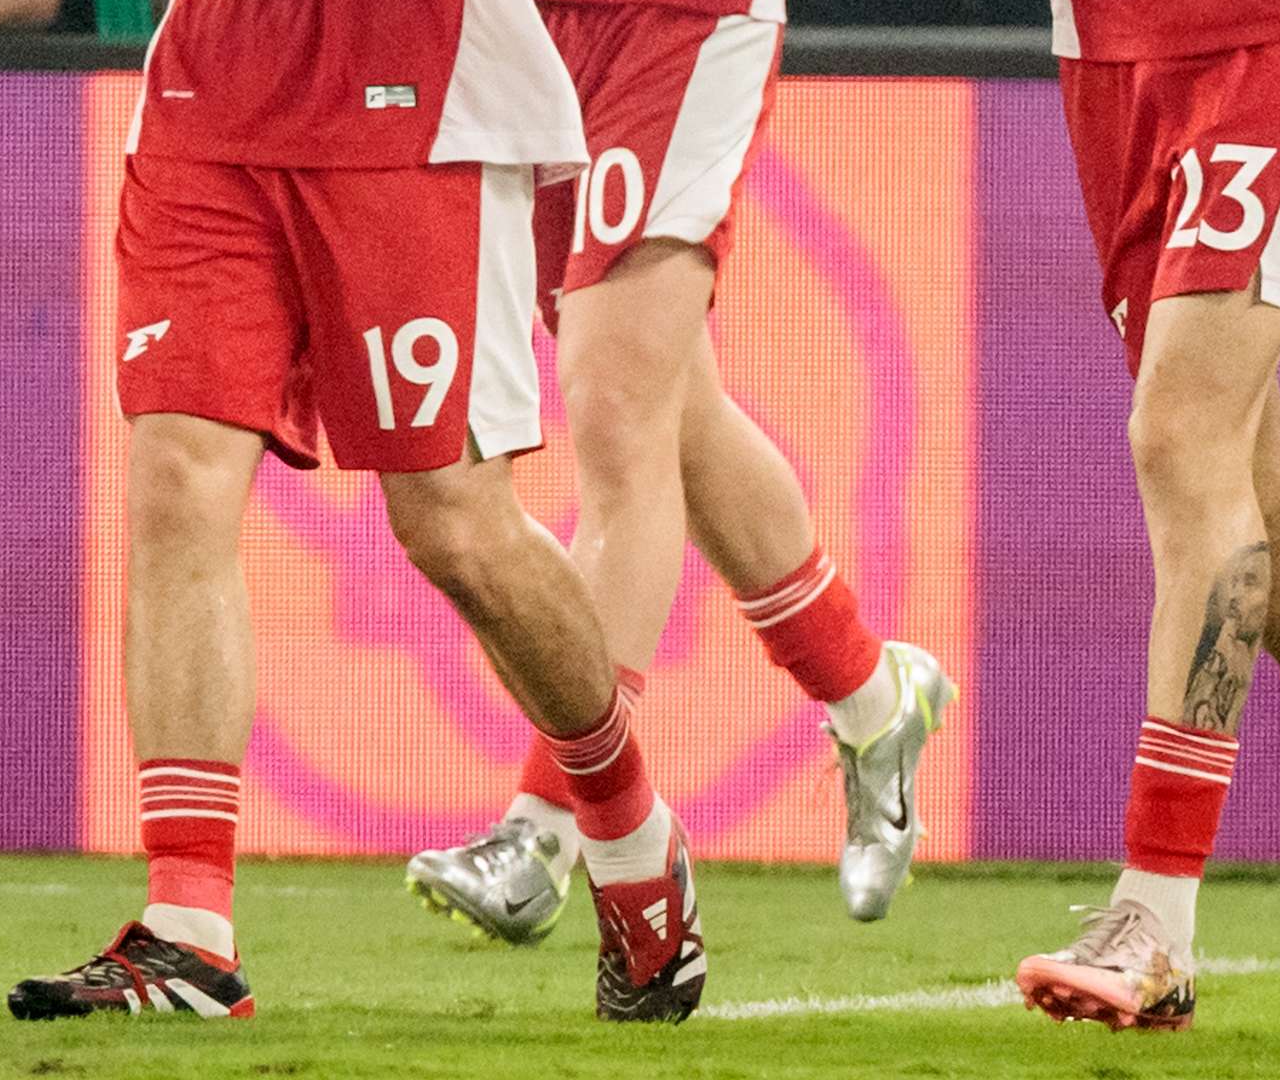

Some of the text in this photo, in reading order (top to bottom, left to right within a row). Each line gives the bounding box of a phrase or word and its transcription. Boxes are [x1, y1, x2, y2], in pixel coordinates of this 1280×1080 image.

[572, 146, 646, 255] 10
[1166, 143, 1278, 251] 23
[362, 317, 459, 430] 19
